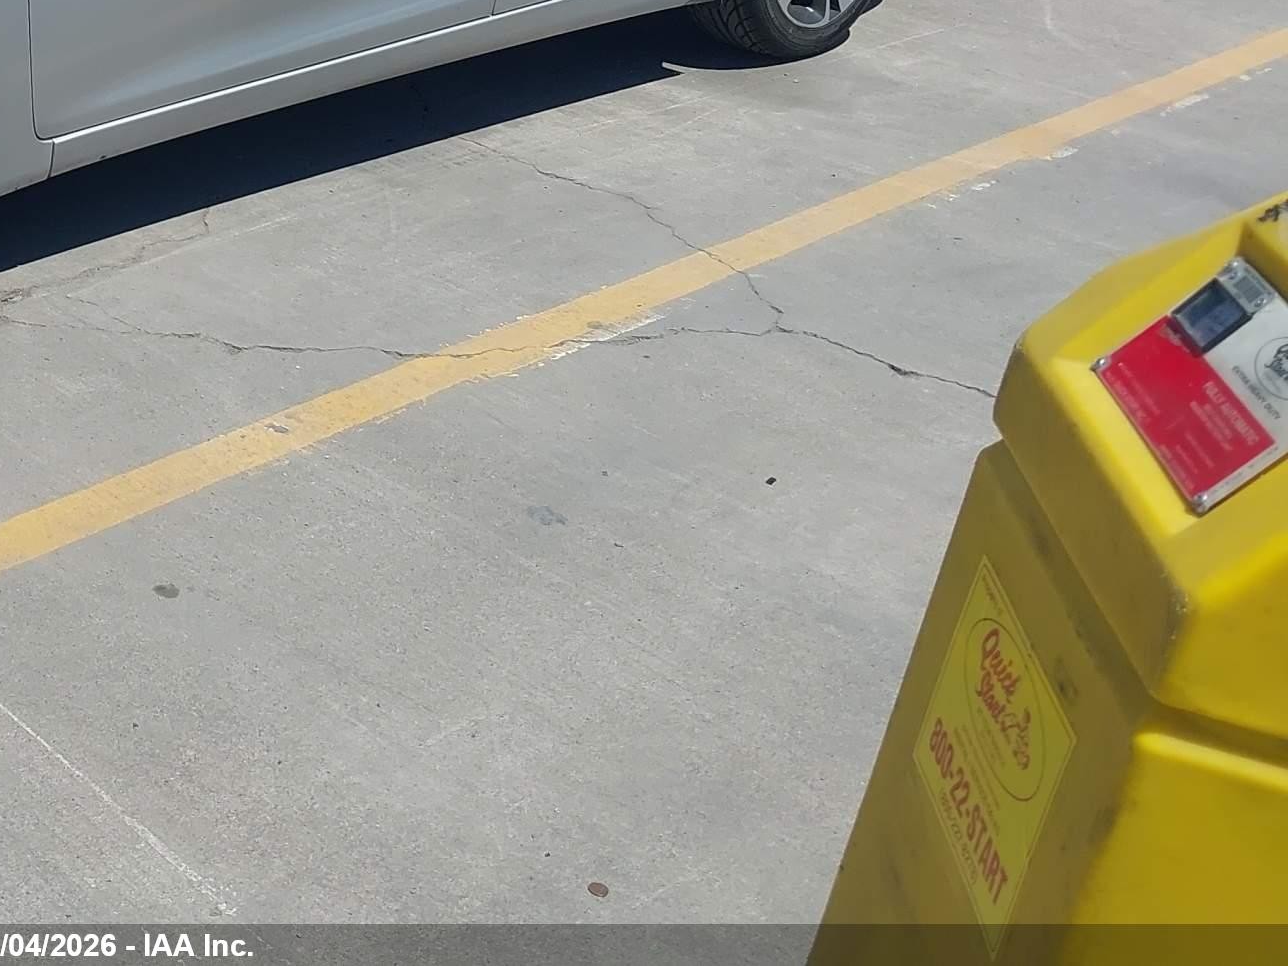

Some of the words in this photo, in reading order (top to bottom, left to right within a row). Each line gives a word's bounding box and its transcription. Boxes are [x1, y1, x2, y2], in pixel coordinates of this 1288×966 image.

[1203, 380, 1226, 405] FULLY
[1219, 399, 1260, 447] AUTOMATIC
[1263, 402, 1281, 421] DUTY
[981, 628, 1021, 704] Quick
[976, 669, 1010, 733] Start
[929, 716, 1008, 905] 800-22-START
